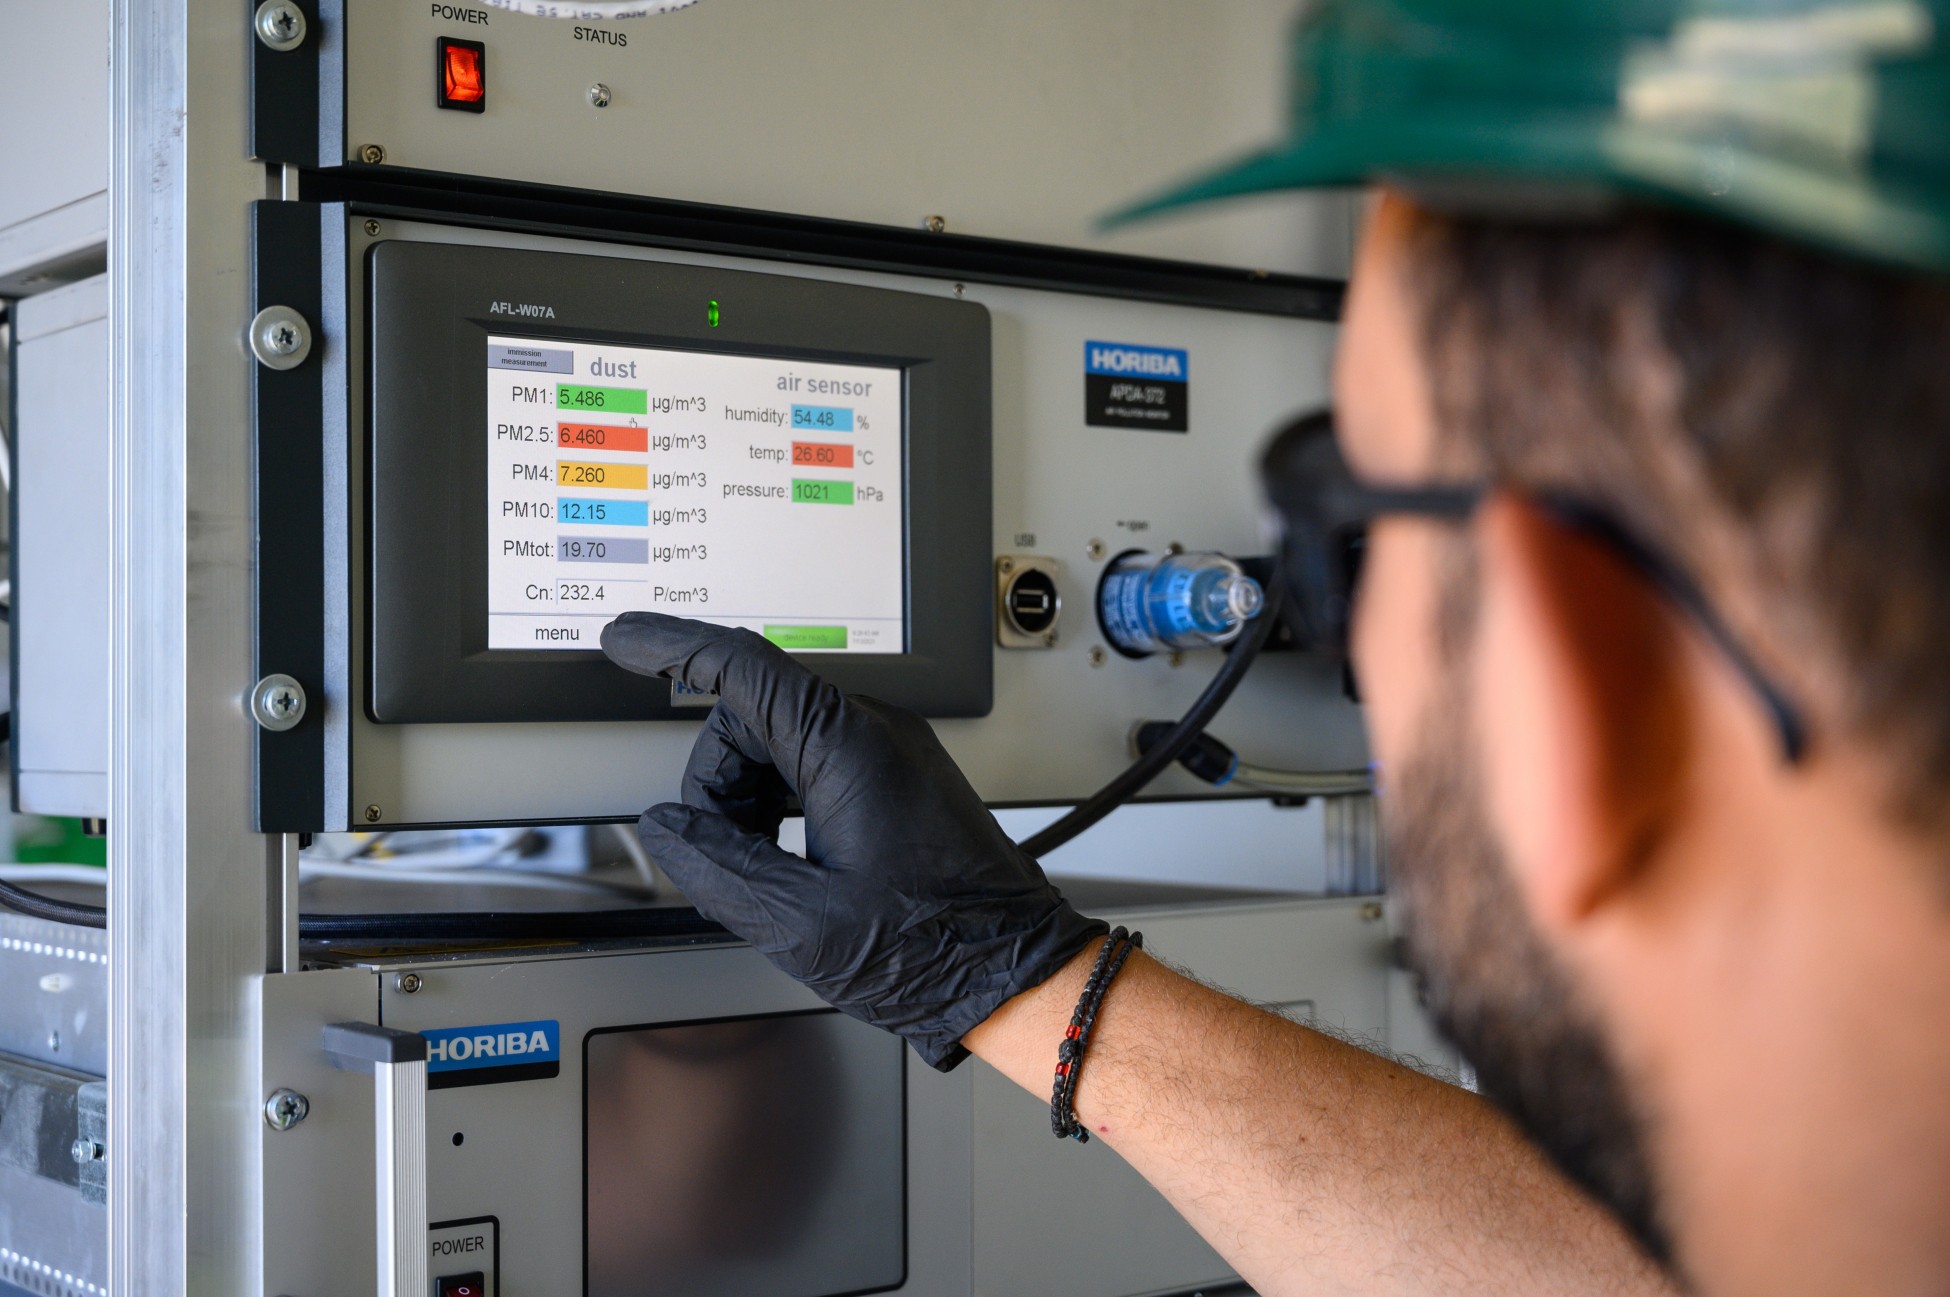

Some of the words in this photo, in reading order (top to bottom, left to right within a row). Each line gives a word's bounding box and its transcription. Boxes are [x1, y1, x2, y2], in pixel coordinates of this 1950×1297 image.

[431, 3, 489, 26] POWER
[573, 26, 628, 47] STATUS
[489, 301, 556, 319] AFL-W07A
[507, 348, 542, 357] immission
[1092, 348, 1182, 376] HORIBA
[501, 358, 547, 368] measurement
[590, 356, 637, 379] dust
[777, 372, 802, 392] air
[807, 378, 873, 397] sensor
[512, 386, 554, 404] PM1:
[559, 389, 605, 407] 5.486
[725, 405, 789, 427] humidity:
[794, 409, 835, 426] 54.48
[857, 415, 870, 430] %
[497, 424, 554, 443] PM2.5:
[560, 427, 606, 445] 6.460
[749, 445, 789, 464] temp:
[794, 446, 835, 463] 26.60
[857, 450, 874, 465] °C
[512, 464, 554, 482] PM4:
[560, 465, 605, 483] 7.260
[723, 482, 790, 499] pressure:
[795, 484, 830, 500] 1021
[857, 486, 884, 502] hPa
[502, 501, 554, 519] PM10:
[561, 503, 606, 520] 12.15
[503, 540, 554, 557] PMtot:
[561, 542, 606, 558] 19.70
[525, 584, 553, 601] Cn:
[559, 584, 605, 601] 232.4
[654, 586, 709, 602] P/cm^3
[535, 627, 580, 641] menu
[427, 1030, 550, 1062] HORIBA
[432, 1236, 485, 1257] POWER
